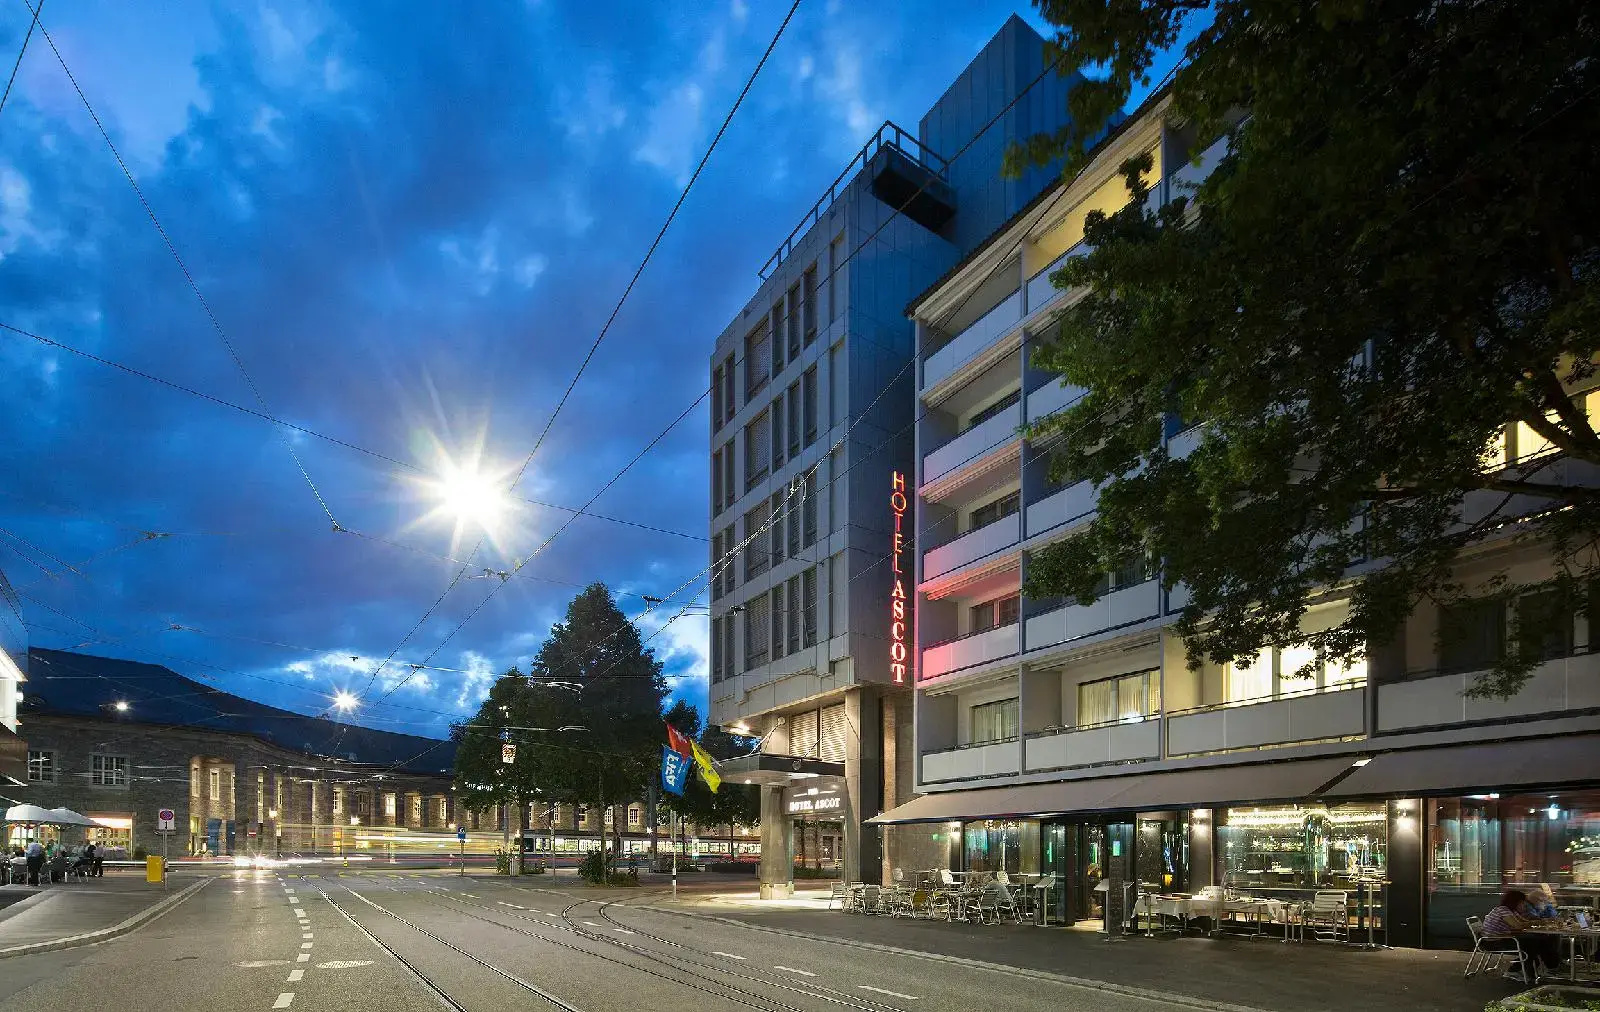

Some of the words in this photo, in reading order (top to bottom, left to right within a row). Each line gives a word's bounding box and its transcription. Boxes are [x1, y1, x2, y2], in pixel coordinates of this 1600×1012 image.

[891, 470, 907, 574] HOTEL
[891, 579, 907, 683] ASCOT
[789, 800, 813, 811] HOTEL
[815, 798, 840, 809] ASCOT
